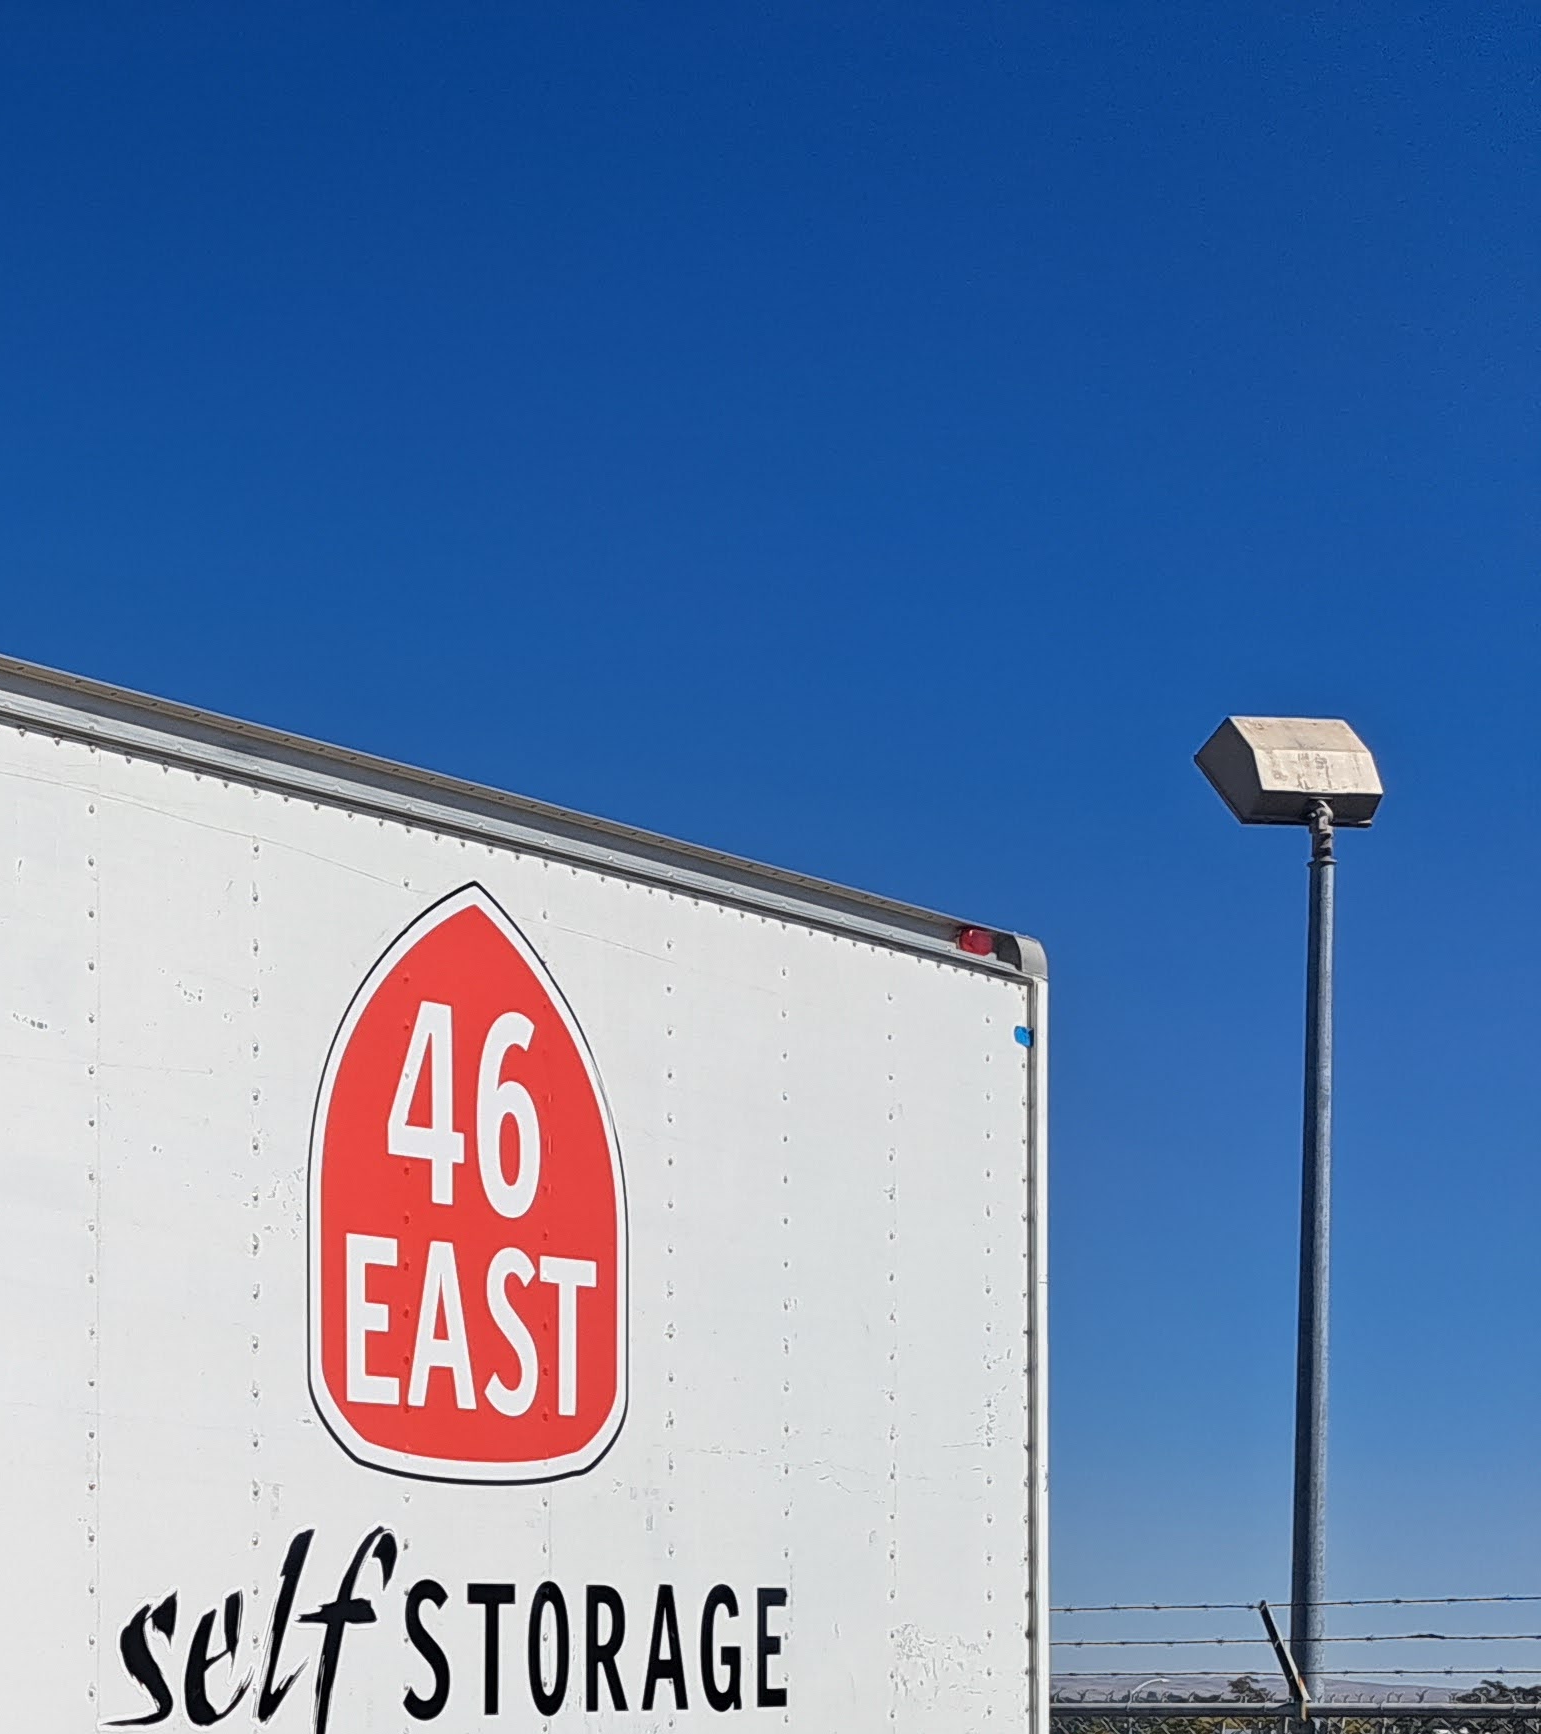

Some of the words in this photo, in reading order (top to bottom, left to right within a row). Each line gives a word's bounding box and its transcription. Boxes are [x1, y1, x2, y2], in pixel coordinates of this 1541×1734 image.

[387, 1000, 541, 1218] 46
[345, 1232, 597, 1417] EAST
[402, 1578, 788, 1721] STORAGE
